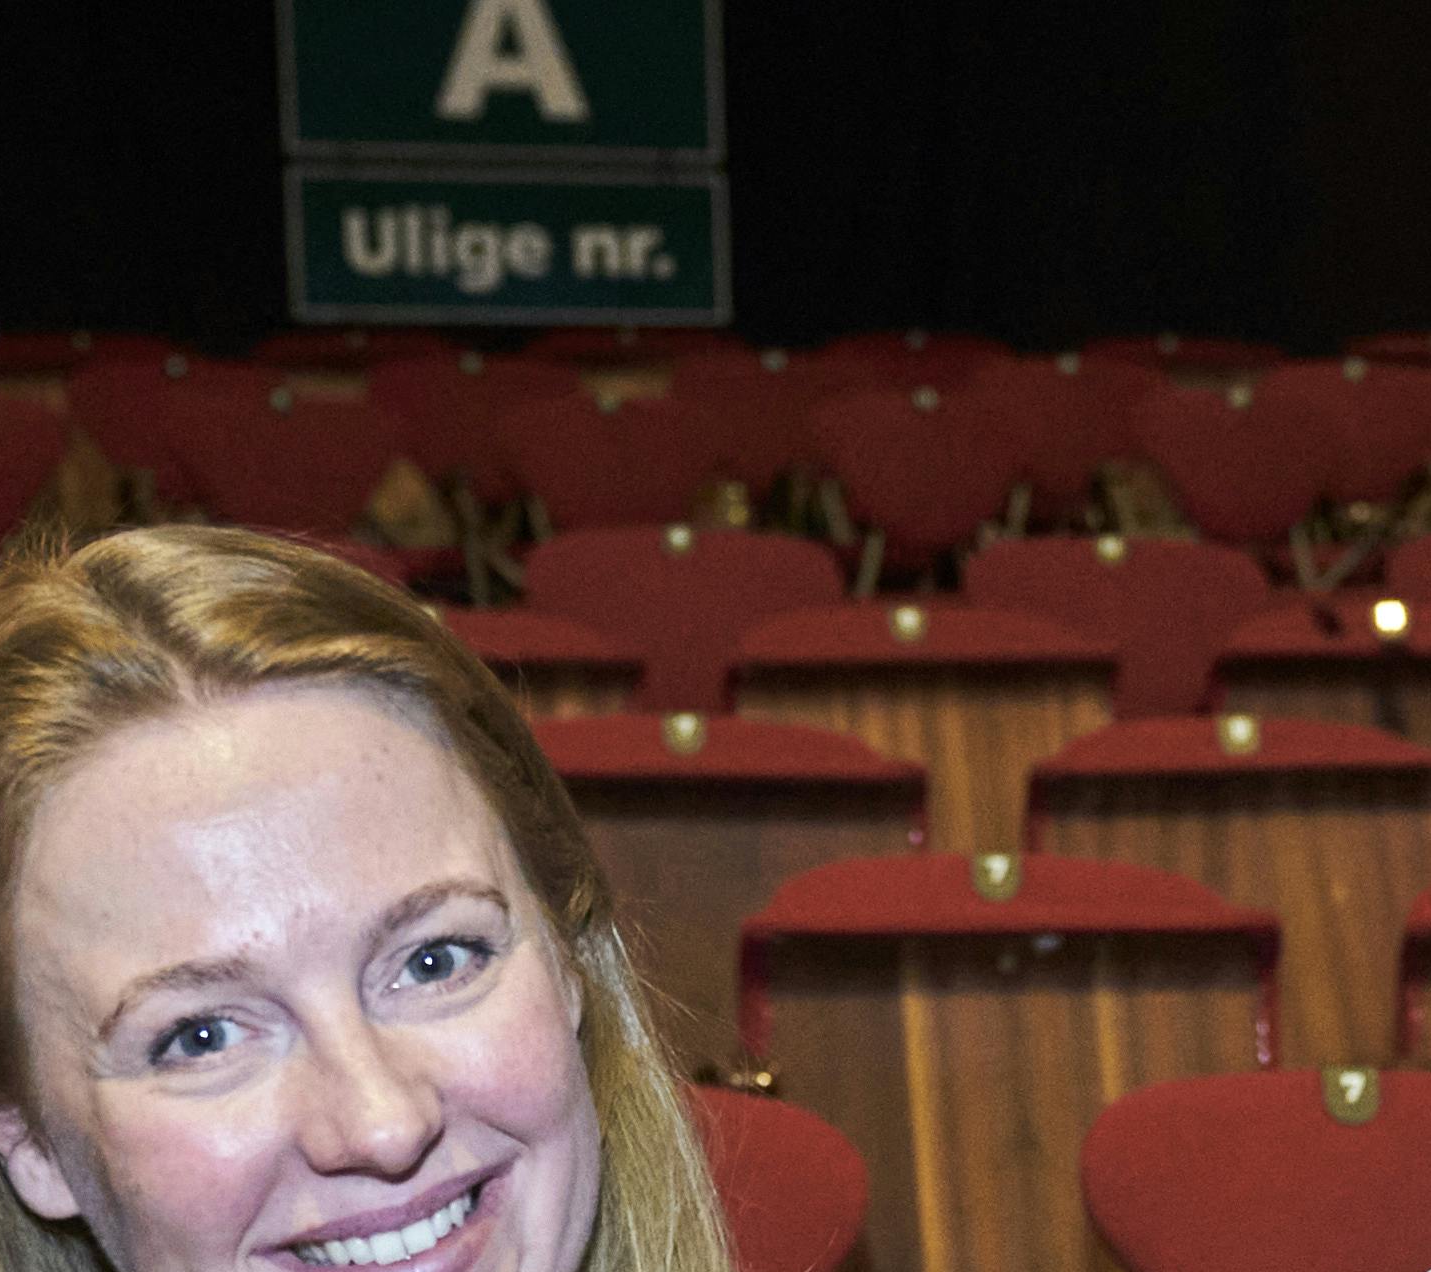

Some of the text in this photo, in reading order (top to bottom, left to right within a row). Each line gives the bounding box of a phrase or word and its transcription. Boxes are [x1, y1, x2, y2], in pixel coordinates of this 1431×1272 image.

[436, 0, 589, 121] A
[341, 205, 675, 294] Ulige nr.
[985, 853, 1009, 884] 7
[1340, 1070, 1367, 1104] 7
